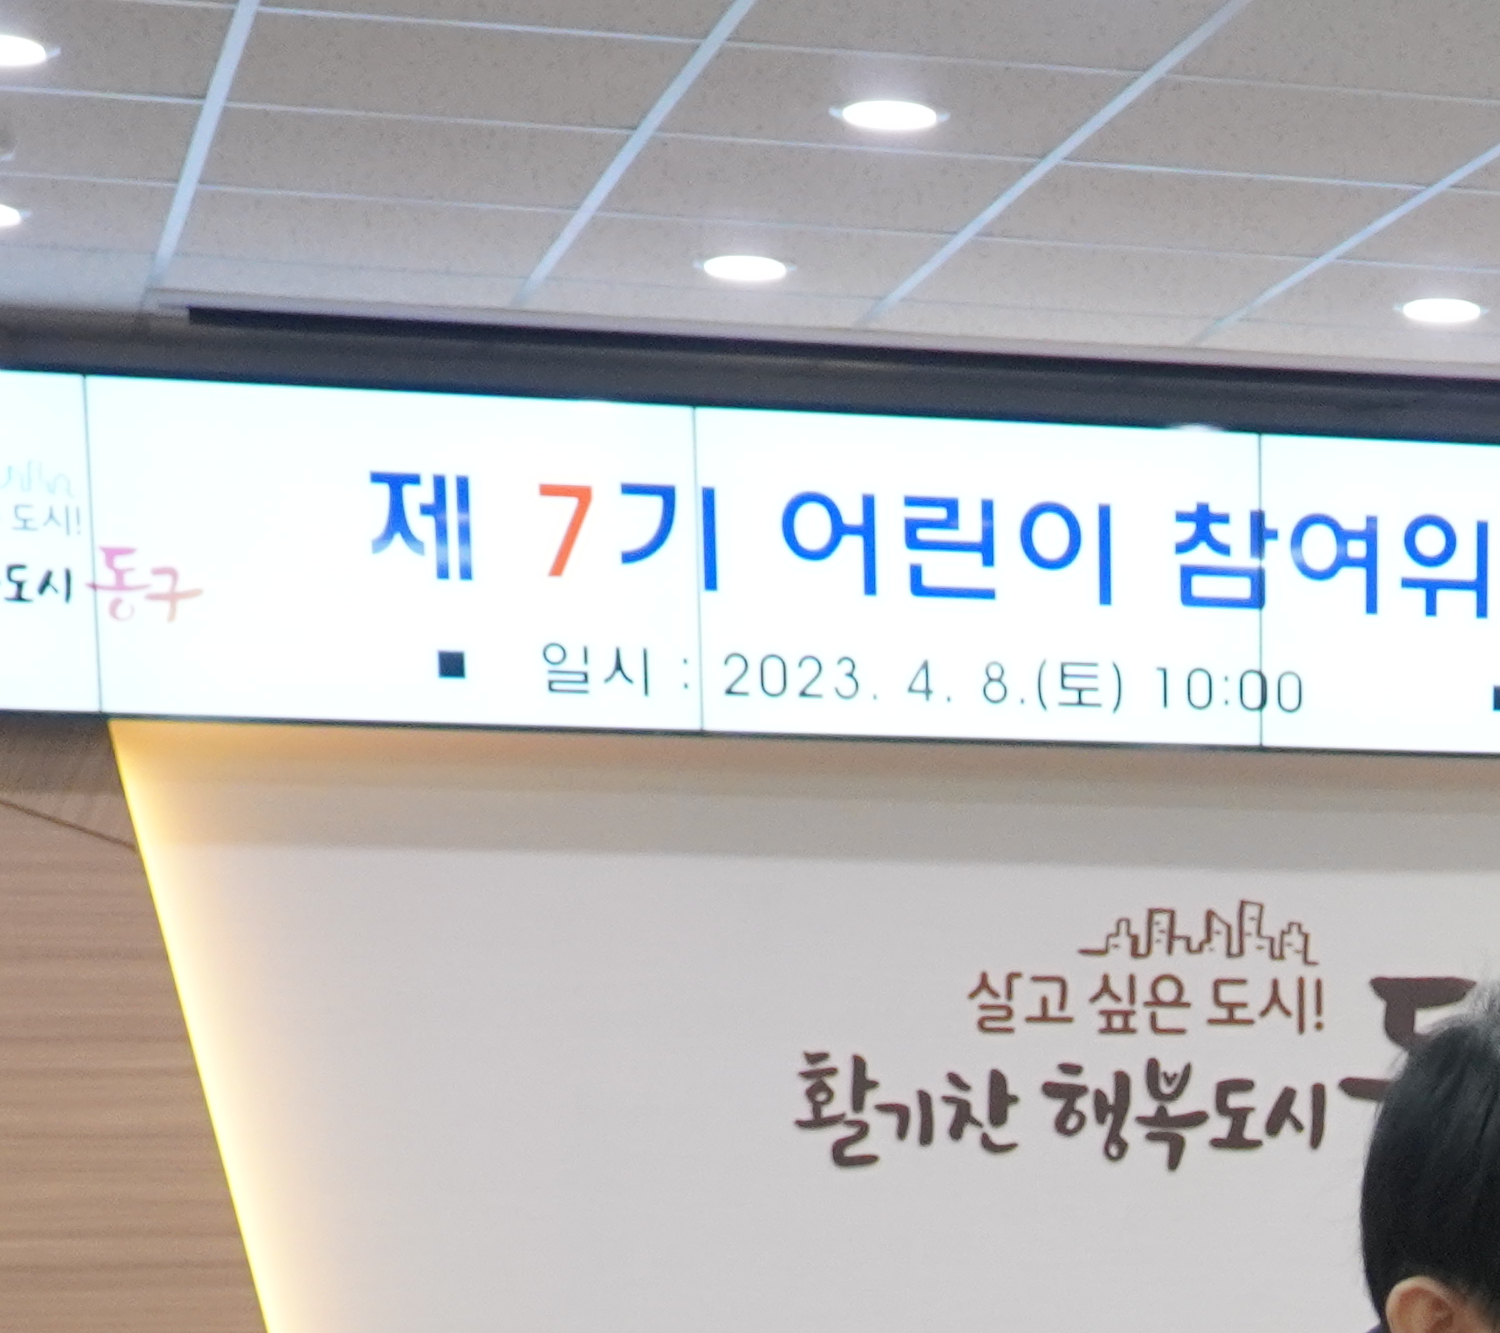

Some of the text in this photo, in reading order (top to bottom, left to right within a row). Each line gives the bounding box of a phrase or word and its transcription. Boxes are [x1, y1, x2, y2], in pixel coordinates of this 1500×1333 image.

[12, 503, 83, 536] 도시!
[368, 469, 474, 582] 제
[537, 481, 720, 593] 7기
[779, 488, 1115, 607] 어린이
[85, 544, 204, 623] 동구
[541, 641, 652, 698] 일시
[721, 651, 881, 703] 2023.
[906, 658, 954, 705] 4.
[1153, 665, 1305, 714] 10:00
[967, 970, 1325, 1036] 살고 싶은 도시!
[794, 1050, 1327, 1172] 활기찬 행복도시
